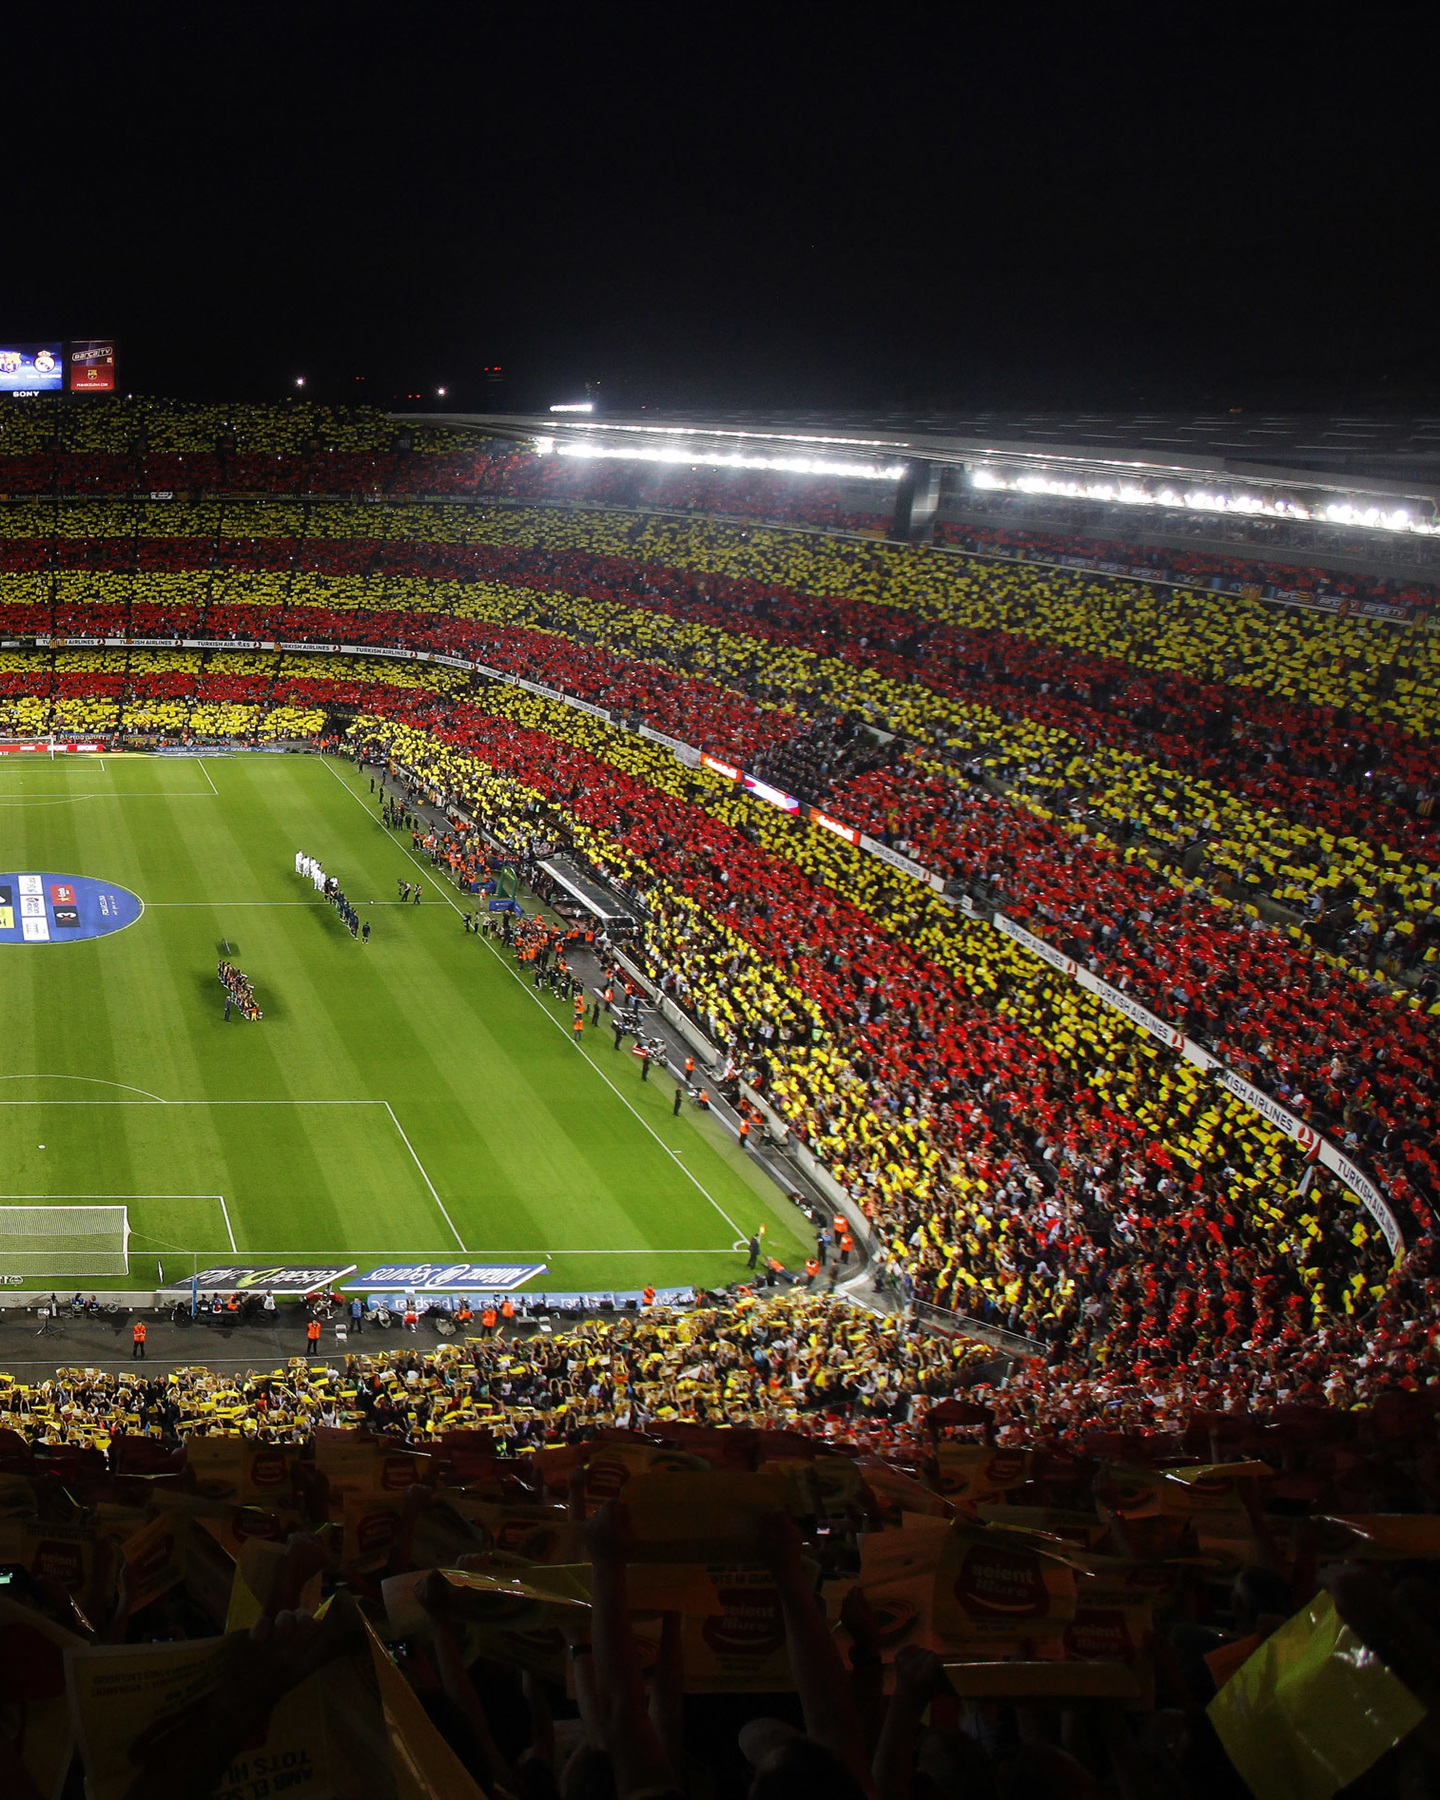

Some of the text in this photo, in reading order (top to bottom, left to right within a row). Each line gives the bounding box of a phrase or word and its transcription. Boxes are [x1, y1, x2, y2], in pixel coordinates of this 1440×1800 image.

[381, 649, 407, 657] AIRLINES
[1095, 981, 1169, 1040] TURKISH AIRLINES
[1248, 1089, 1294, 1132] AIRLINES
[1336, 1158, 1373, 1204] TURKISH
[362, 1264, 531, 1284] Allianz Seguros
[971, 1563, 1035, 1585] seient
[975, 1578, 1029, 1598] lliure
[253, 1748, 312, 1776] TOTS
[273, 1766, 313, 1791] AMB
